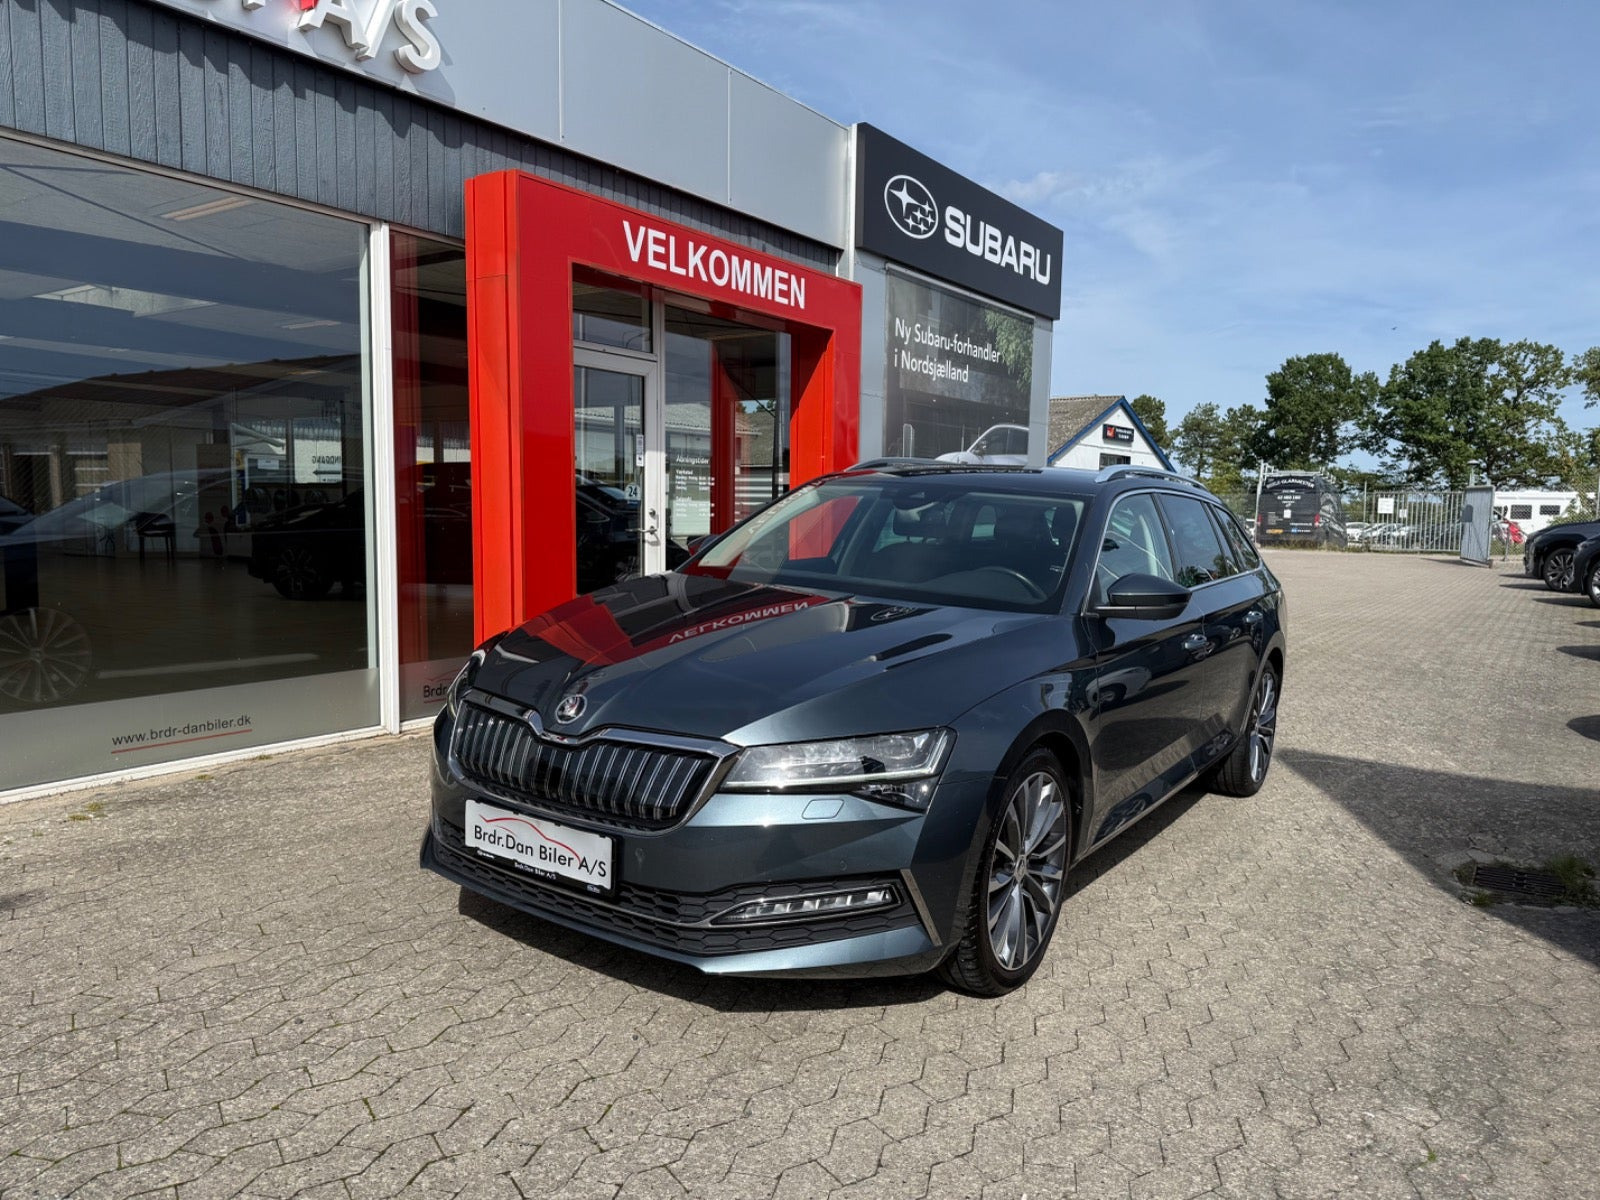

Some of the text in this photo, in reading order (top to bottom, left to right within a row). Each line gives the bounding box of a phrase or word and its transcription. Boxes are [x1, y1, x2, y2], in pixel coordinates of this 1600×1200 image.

[622, 220, 806, 309] VELKOMMEN
[945, 205, 1051, 286] SUBARU
[895, 317, 1001, 363] Ny Subaru-forhandler
[894, 348, 969, 383] i Nordsjælland
[628, 486, 638, 497] 24
[111, 715, 252, 746] www.brdr-danbiler.dk
[474, 825, 533, 857] Brdr.Dan
[539, 845, 574, 867] Biler
[578, 856, 607, 877] A/S
